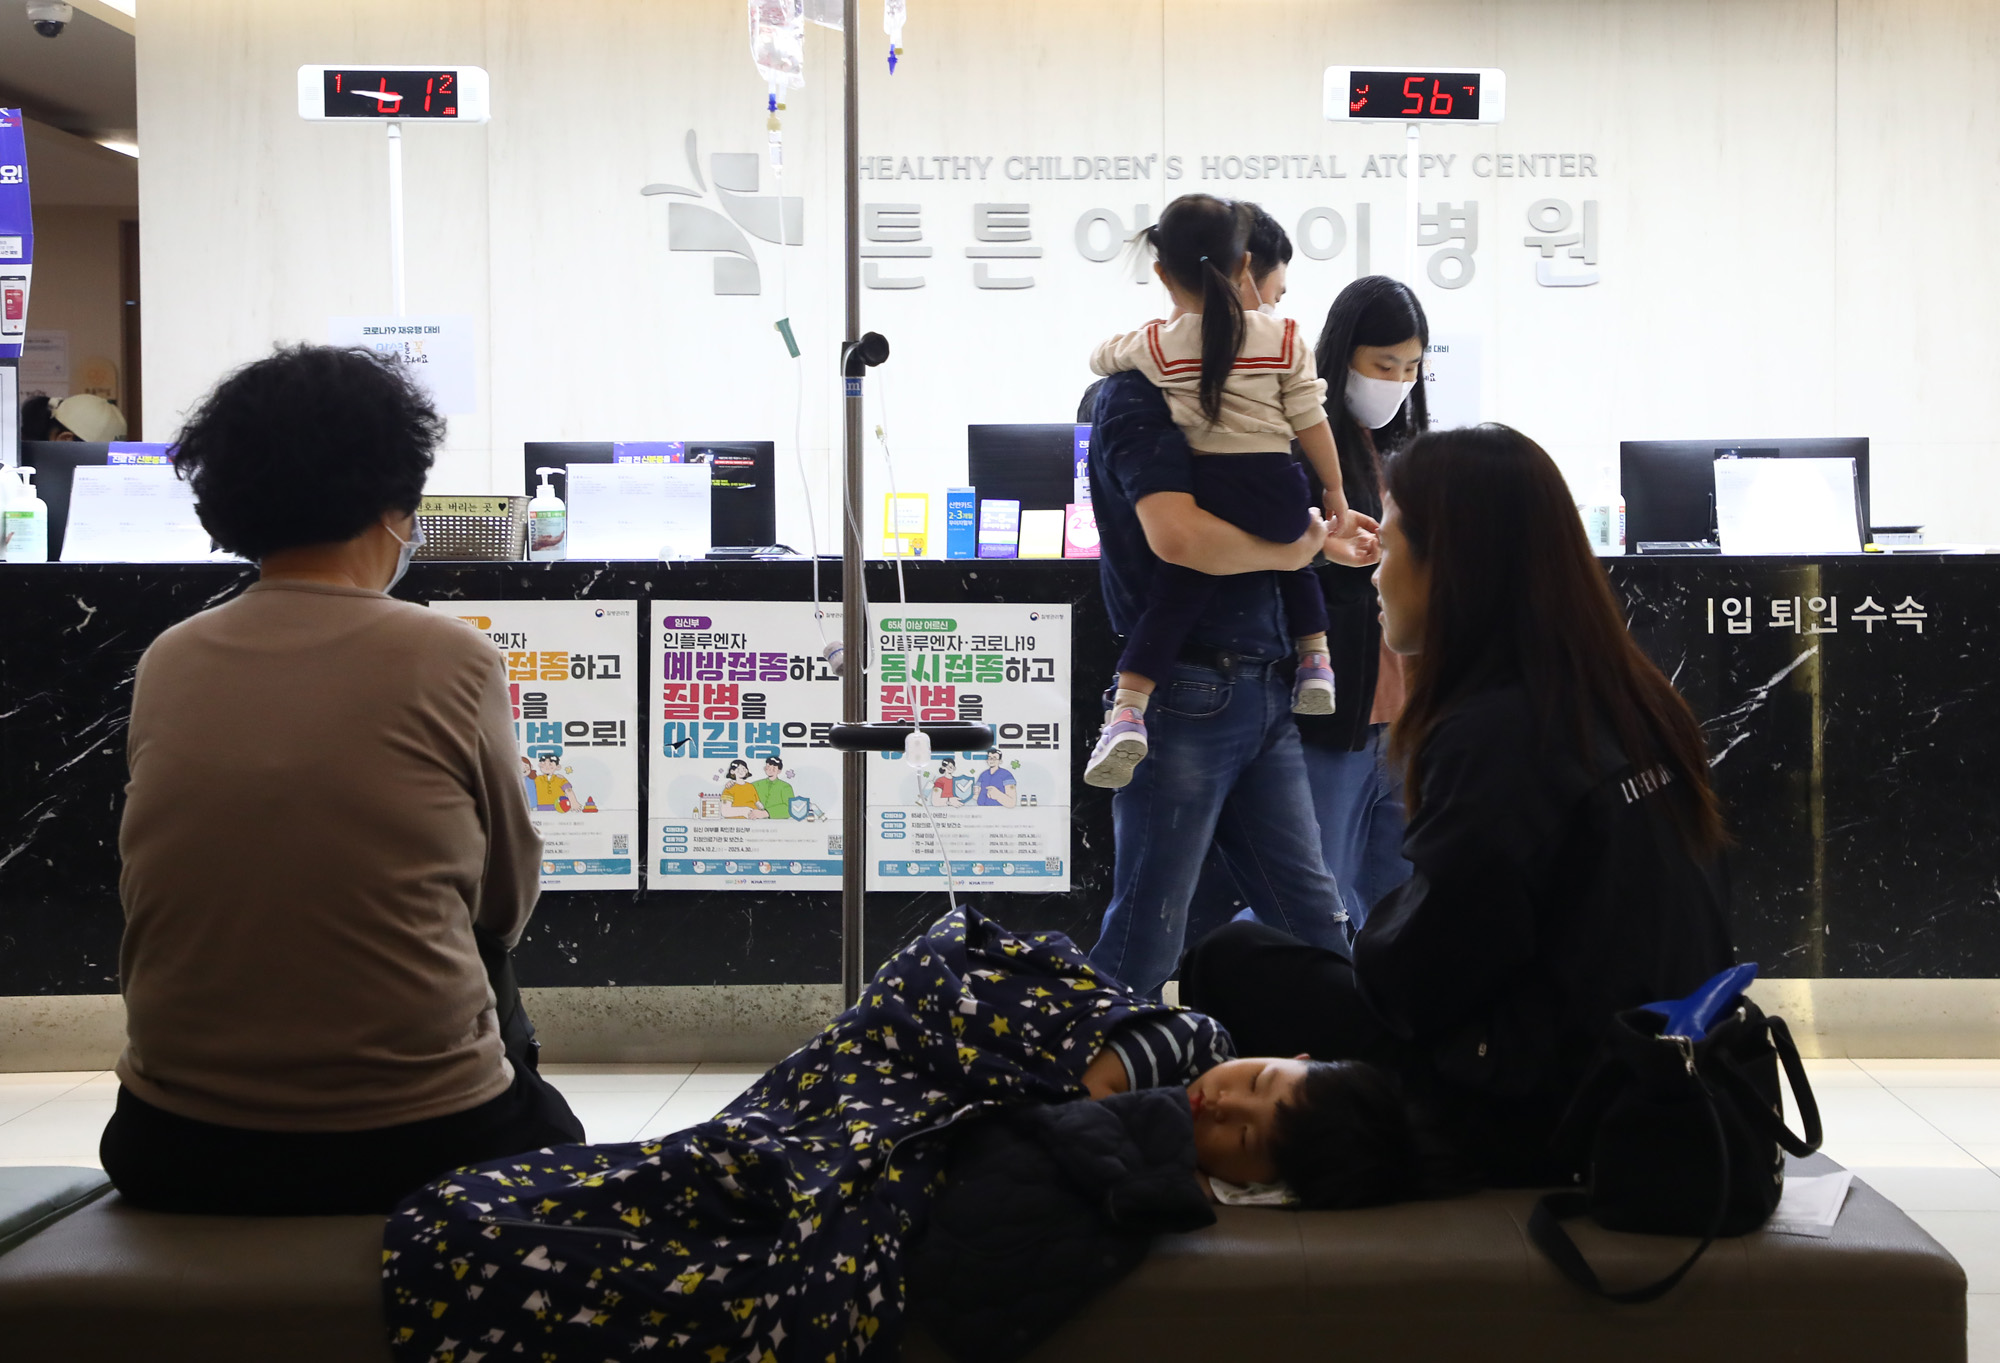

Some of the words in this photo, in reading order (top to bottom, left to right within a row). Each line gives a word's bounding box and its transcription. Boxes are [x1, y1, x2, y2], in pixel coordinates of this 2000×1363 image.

[1401, 77, 1453, 114] 56
[860, 155, 994, 180] HEALTHY
[1201, 154, 1346, 180] HOSPITAL
[1472, 152, 1598, 178] CENTER
[363, 326, 396, 335] 코로나19
[398, 326, 422, 334] 재유행
[424, 325, 440, 334] 대비
[1433, 345, 1449, 353] 대비
[448, 502, 478, 512] 버리는
[483, 502, 493, 513] 곳
[674, 618, 700, 628] 임신부
[906, 620, 922, 630] 이상
[924, 620, 948, 630] 어르신
[1851, 595, 1928, 634] 수속
[663, 632, 747, 650] 인플루엔자
[881, 653, 1055, 683] 동시접종하고
[663, 683, 767, 720] 질병을
[880, 684, 983, 722] 질병을
